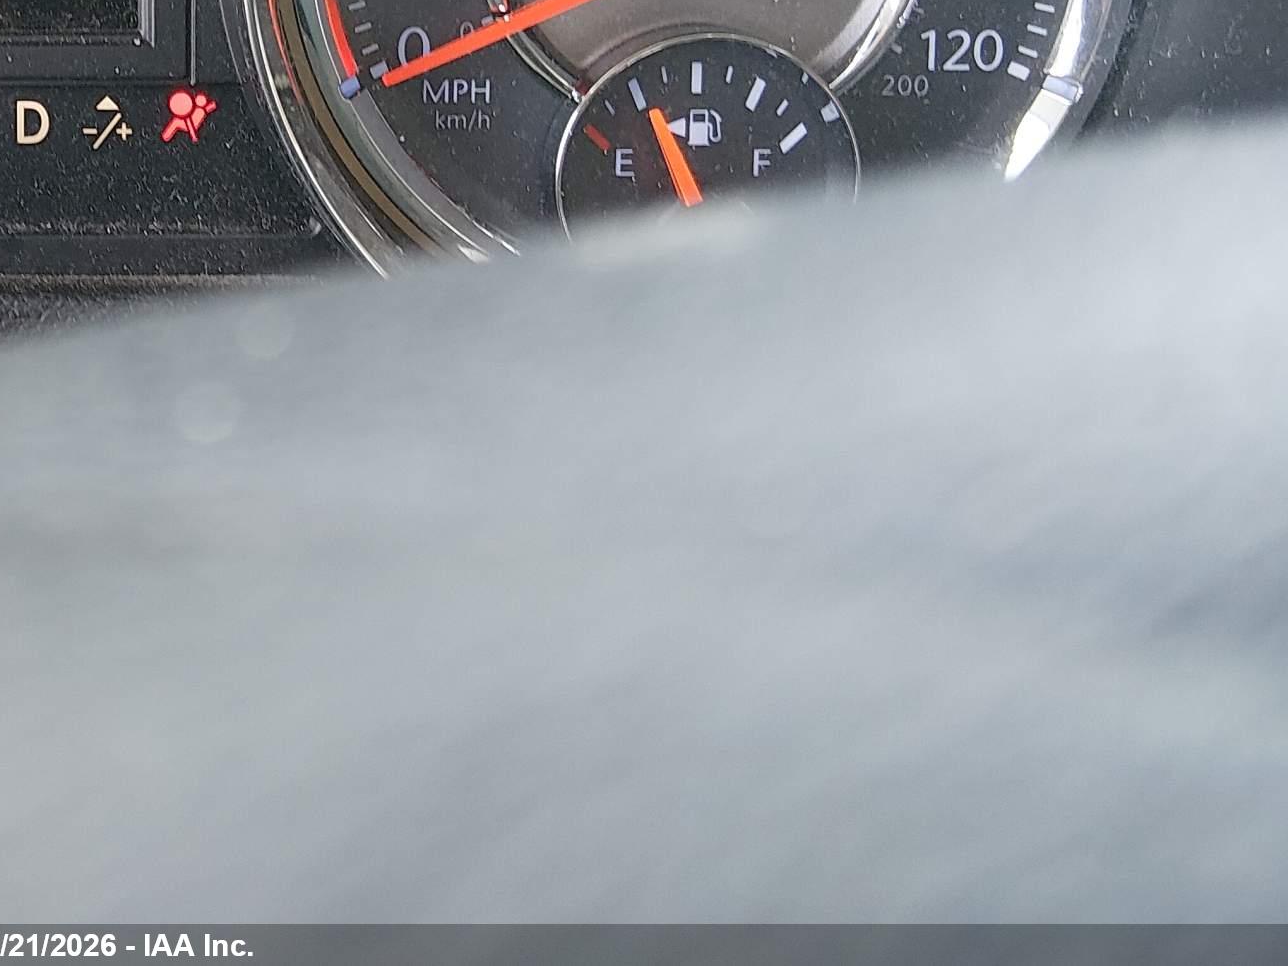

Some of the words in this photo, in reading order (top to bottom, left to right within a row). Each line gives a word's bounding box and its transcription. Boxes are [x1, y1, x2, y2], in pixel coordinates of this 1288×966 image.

[921, 30, 1003, 72] 120
[423, 80, 491, 104] MPH
[881, 74, 928, 97] 200
[16, 101, 50, 144] D
[435, 110, 492, 132] km/h
[616, 150, 633, 175] E
[753, 150, 771, 175] F
